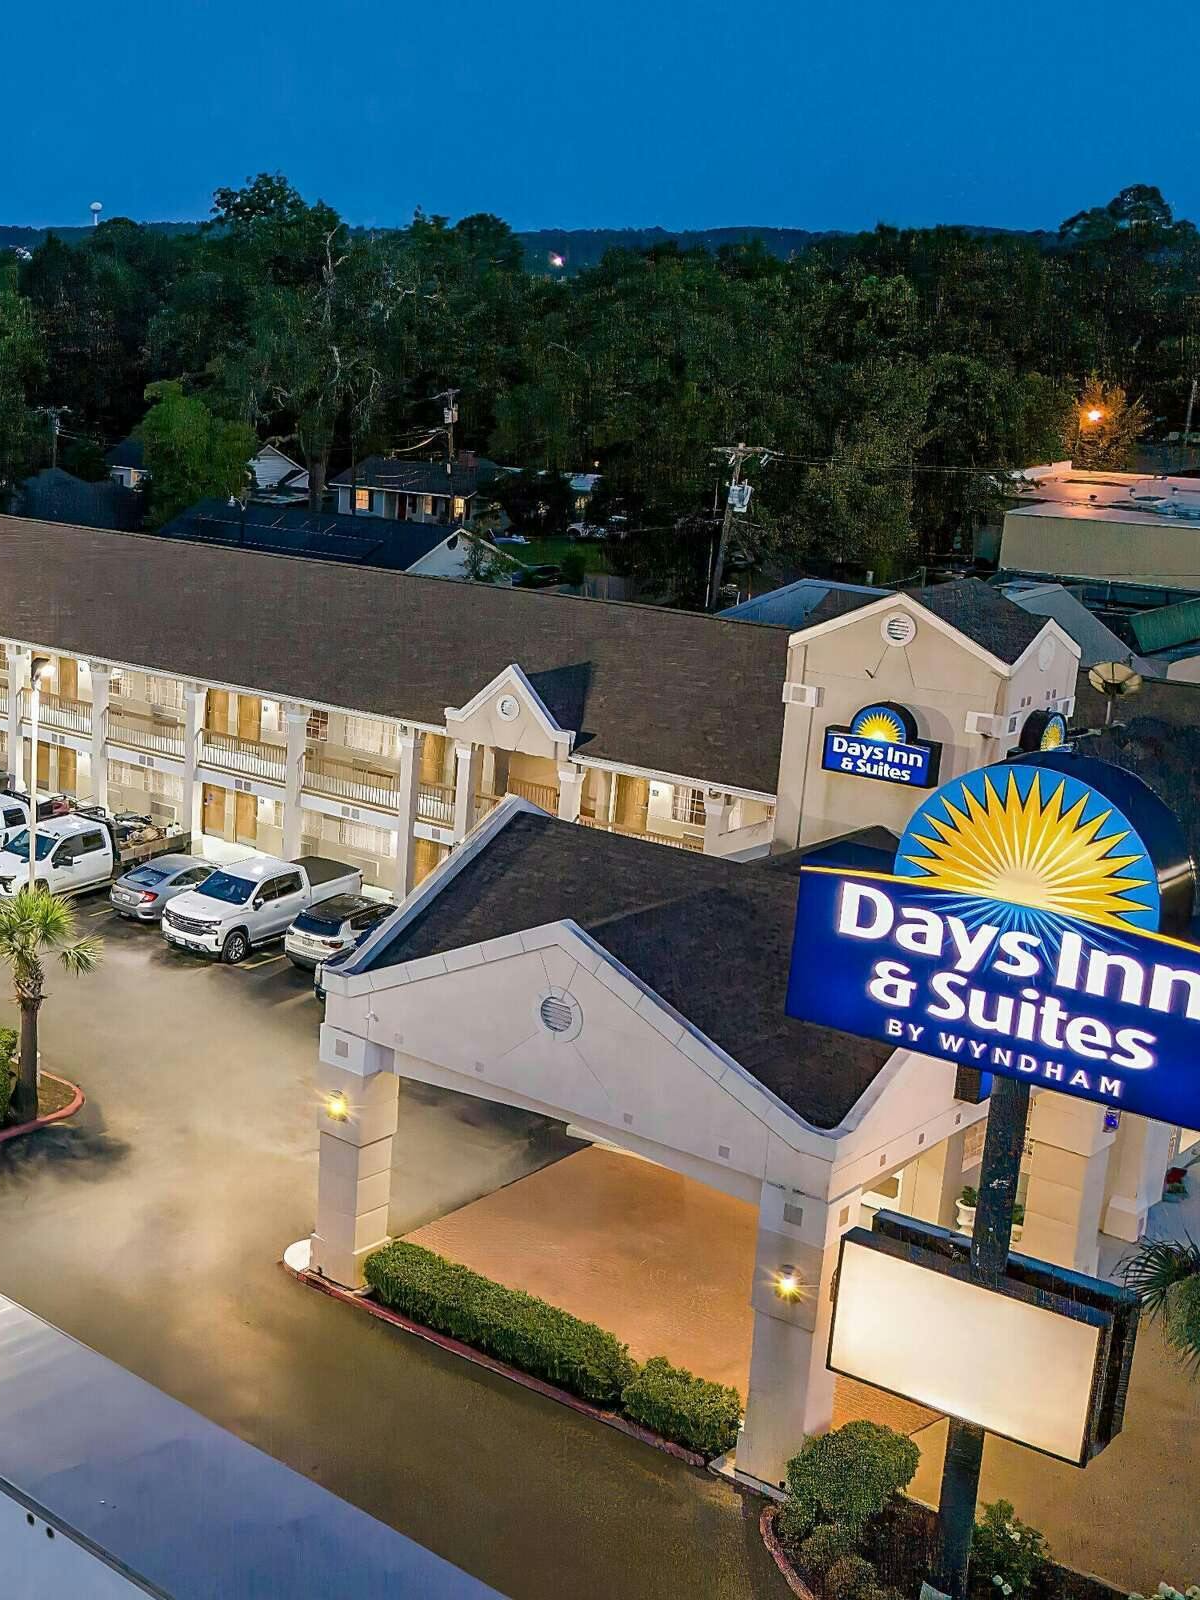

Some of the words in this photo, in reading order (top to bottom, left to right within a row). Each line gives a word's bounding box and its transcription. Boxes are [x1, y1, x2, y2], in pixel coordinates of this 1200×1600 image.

[832, 736, 884, 760] Days
[887, 747, 923, 768] Inn
[840, 757, 854, 771] &
[855, 759, 911, 781] Suites
[836, 881, 1043, 977] Days
[1054, 931, 1200, 1021] Inn
[867, 960, 918, 1008] &
[927, 970, 1159, 1070] Suites
[886, 1018, 926, 1043] BY
[937, 1031, 1124, 1098] WYNDHAM
